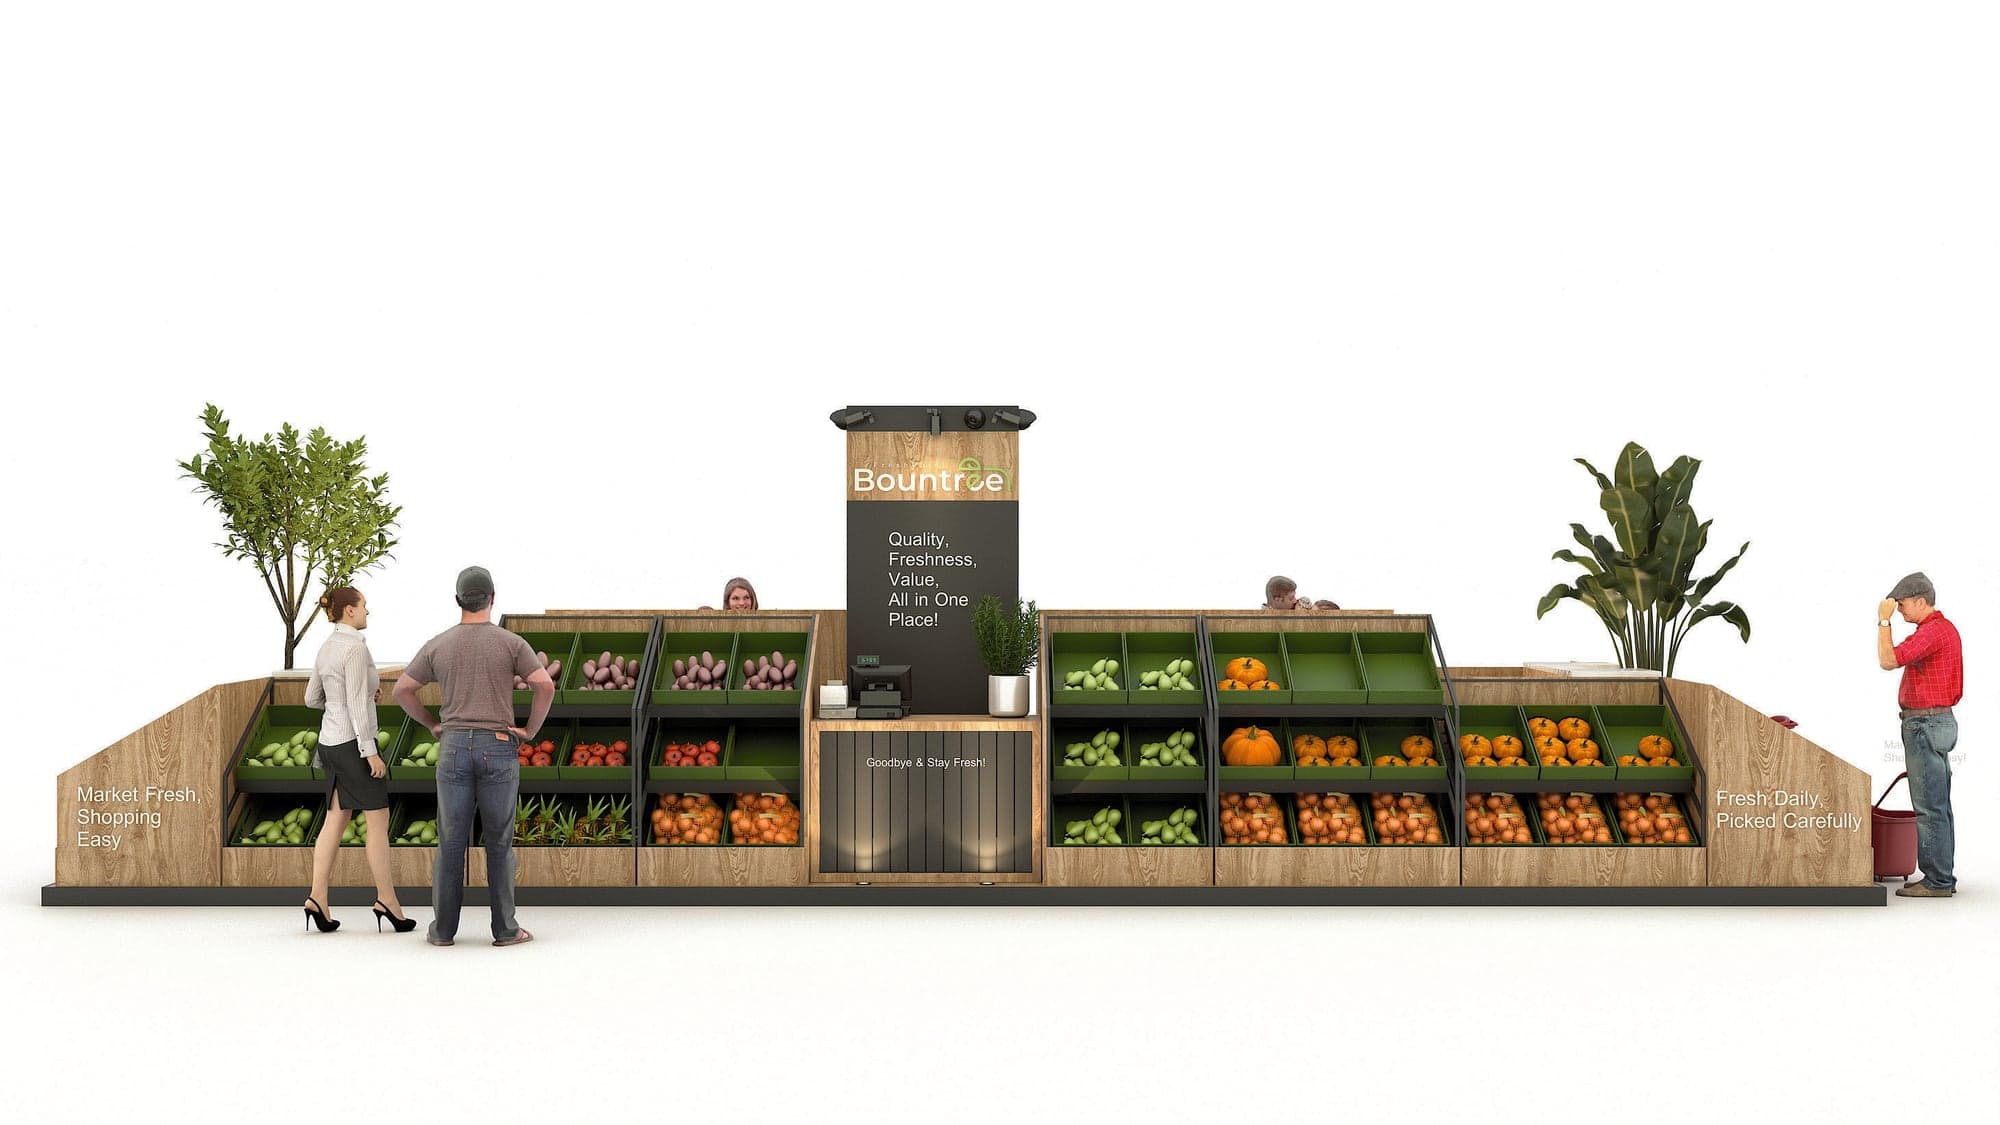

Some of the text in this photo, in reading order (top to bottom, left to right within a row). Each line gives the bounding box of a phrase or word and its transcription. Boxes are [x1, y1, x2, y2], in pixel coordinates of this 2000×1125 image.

[854, 467, 1005, 492] Bountree
[888, 531, 949, 550] Quality,
[889, 551, 977, 569] Freshness,
[888, 571, 939, 589] Value,
[888, 592, 969, 607] All in One
[889, 612, 938, 627] Place!
[866, 757, 986, 769] Goodbye & Stay Fresh!
[77, 786, 201, 804] Market Fresh,
[1716, 790, 1824, 809] Fresh Daily,
[77, 808, 161, 829] Shopping
[1716, 812, 1863, 833] Picked Carefully
[77, 831, 122, 851] Easy
